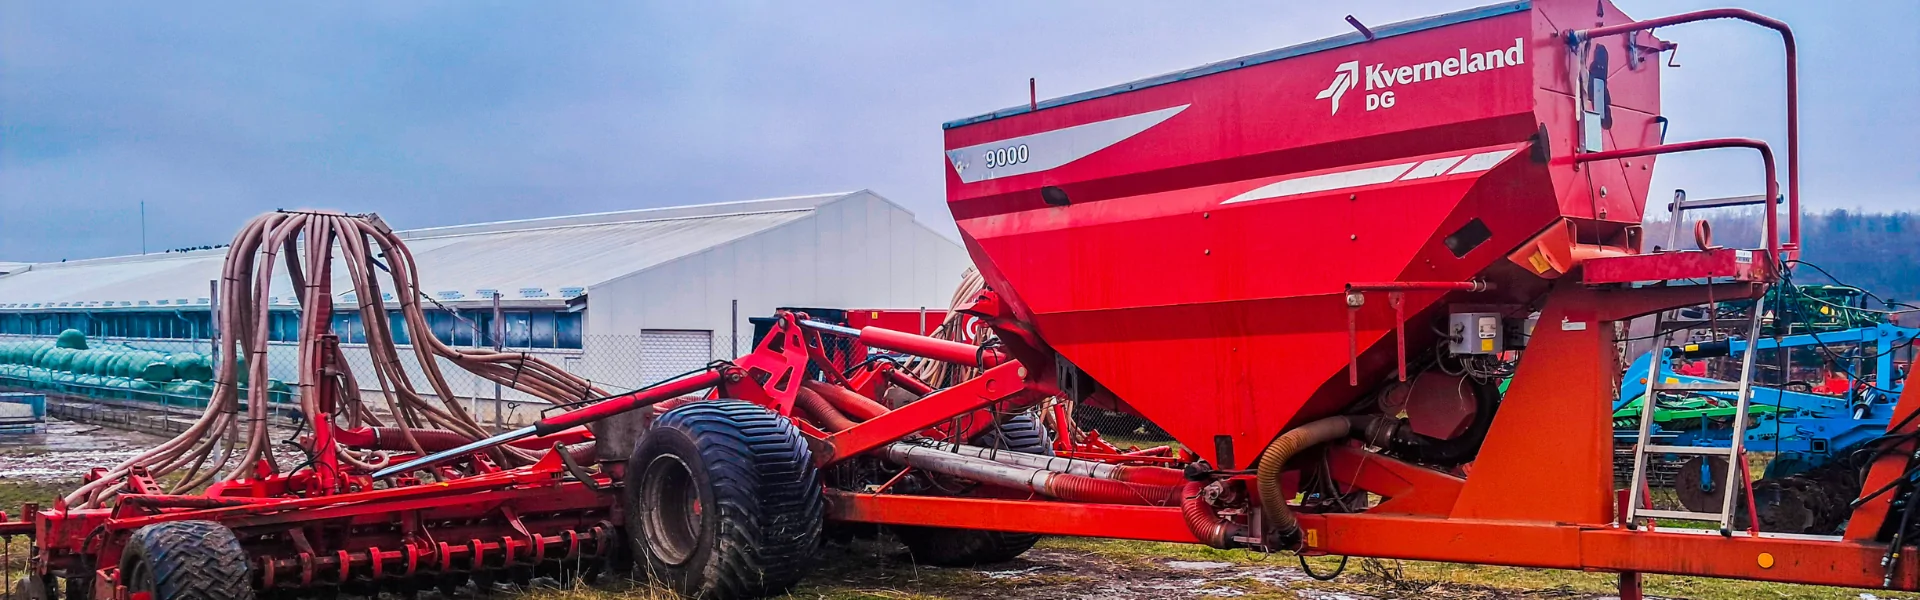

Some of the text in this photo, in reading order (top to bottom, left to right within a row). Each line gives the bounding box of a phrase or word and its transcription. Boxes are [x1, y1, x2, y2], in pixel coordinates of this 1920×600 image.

[1365, 37, 1525, 90] Kverneland
[1366, 91, 1395, 112] DG
[985, 144, 1029, 169] 9000
